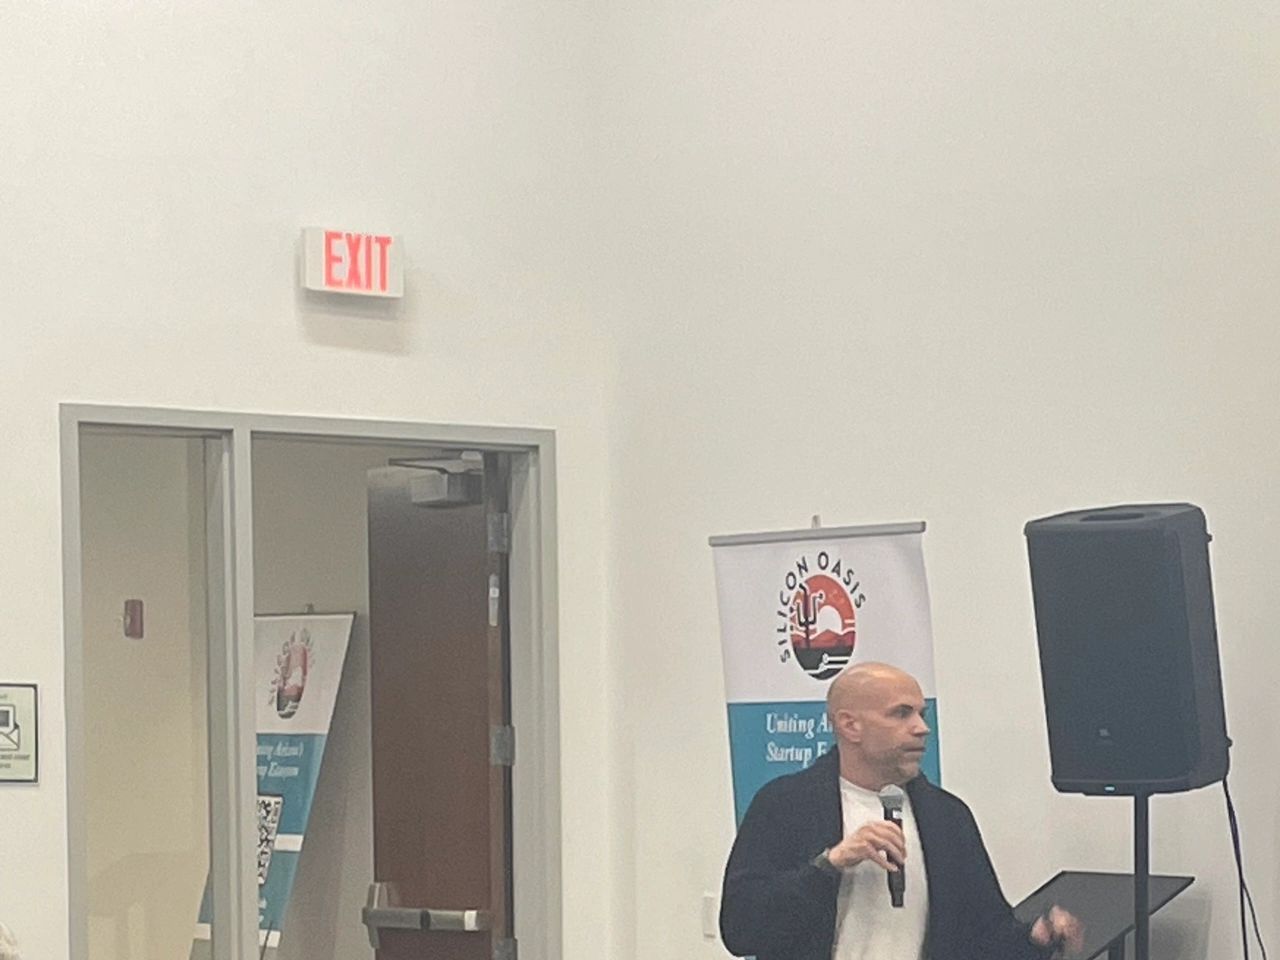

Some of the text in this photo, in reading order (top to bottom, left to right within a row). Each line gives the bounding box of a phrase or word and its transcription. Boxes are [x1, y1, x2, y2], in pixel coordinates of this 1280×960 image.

[324, 231, 392, 292] EXIT
[777, 552, 866, 663] SILICON OASIS
[766, 712, 815, 739] Uniting
[766, 741, 812, 769] Startup
